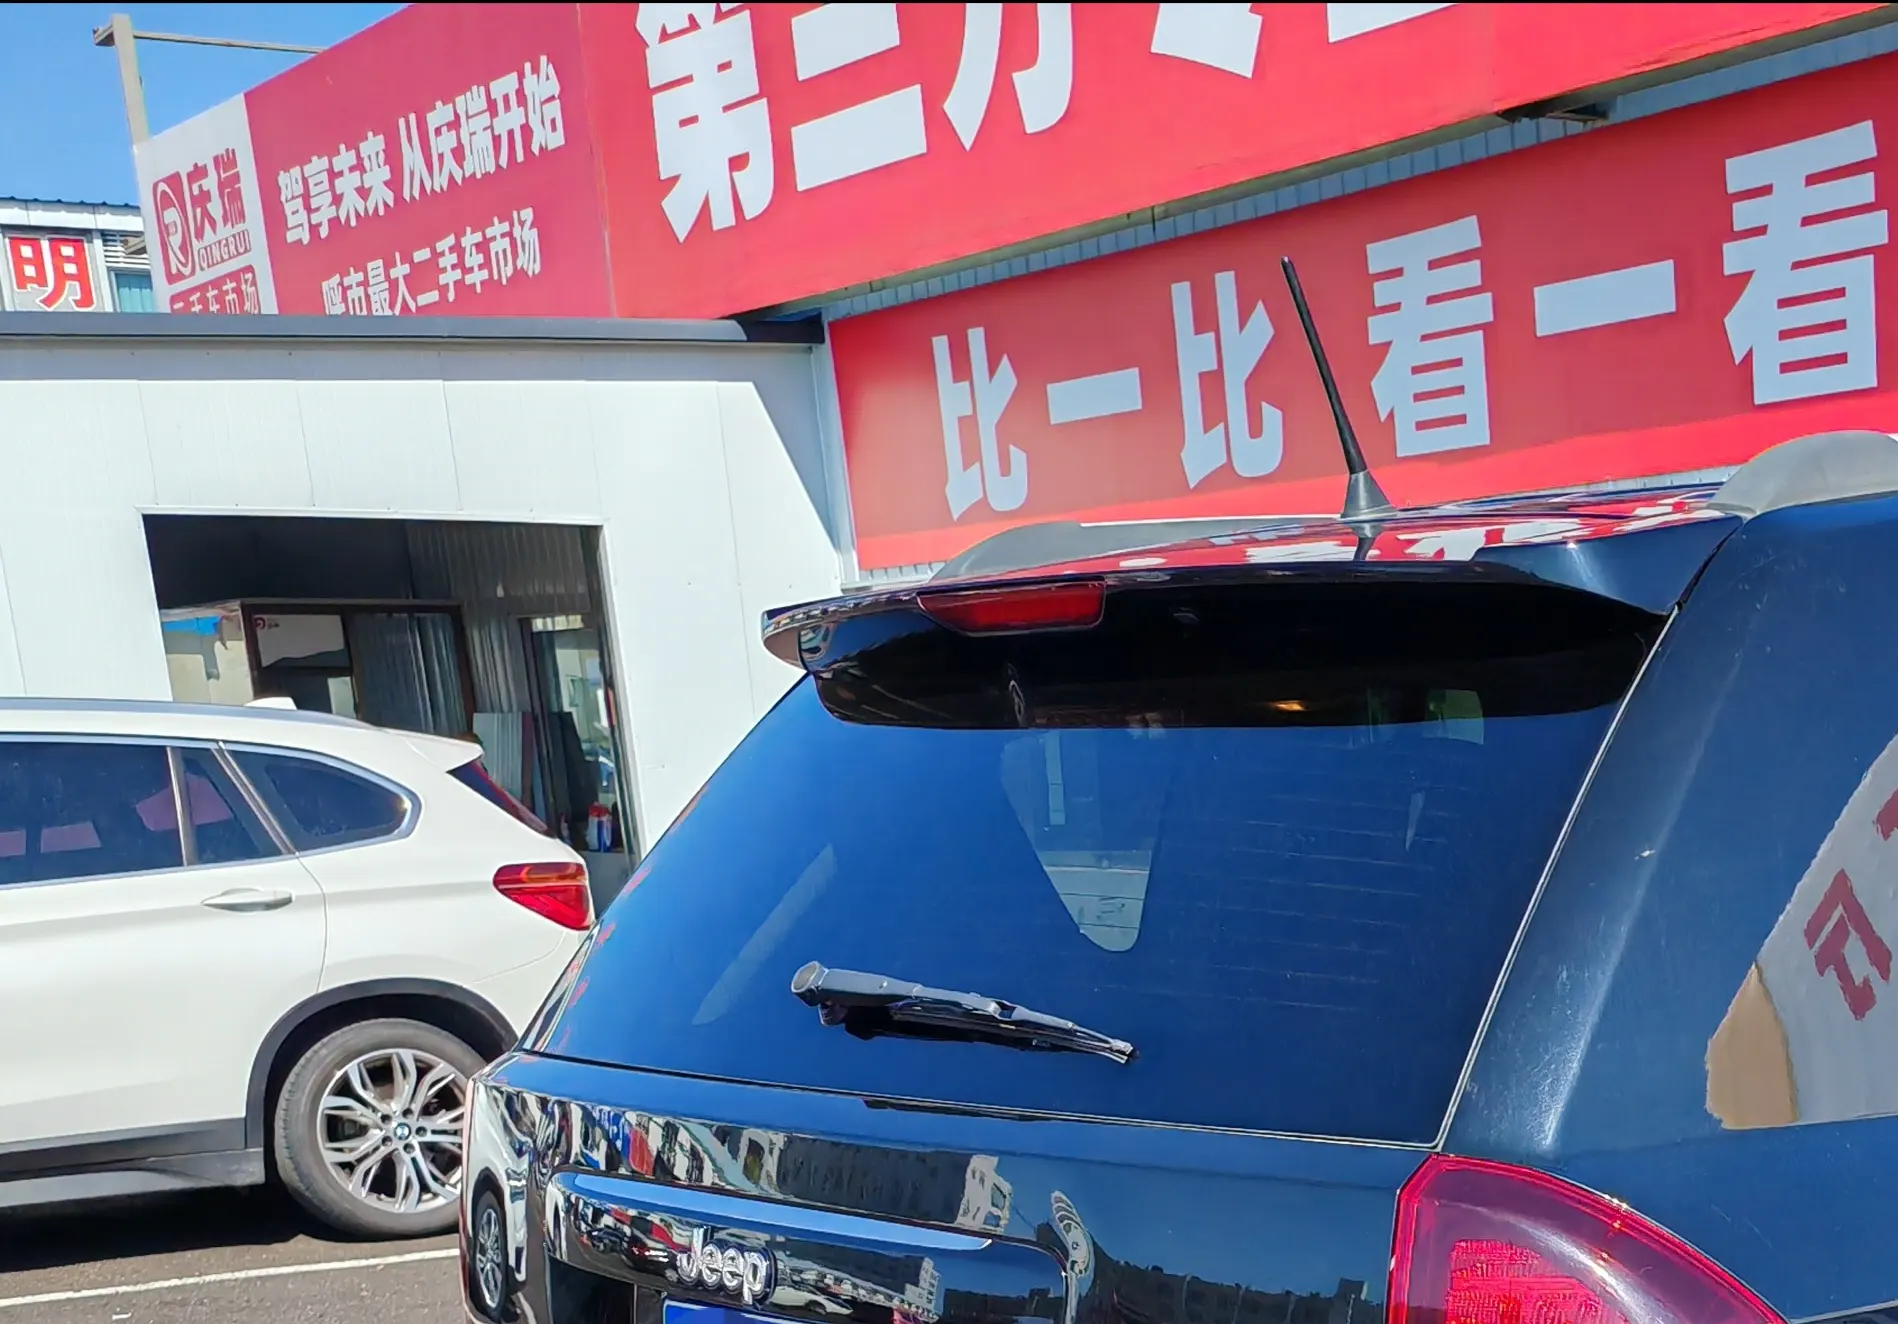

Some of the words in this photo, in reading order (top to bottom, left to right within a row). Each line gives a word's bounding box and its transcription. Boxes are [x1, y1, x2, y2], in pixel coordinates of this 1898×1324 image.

[277, 130, 394, 245] 驾享未来
[398, 55, 565, 203] 从庆瑞开始
[186, 147, 247, 243] 庆瑞
[7, 235, 96, 311] 明
[198, 229, 252, 271] QINGRUI
[931, 271, 1284, 521] 比一比
[1365, 119, 1889, 458] 看一看
[676, 1226, 768, 1305] Jeep
